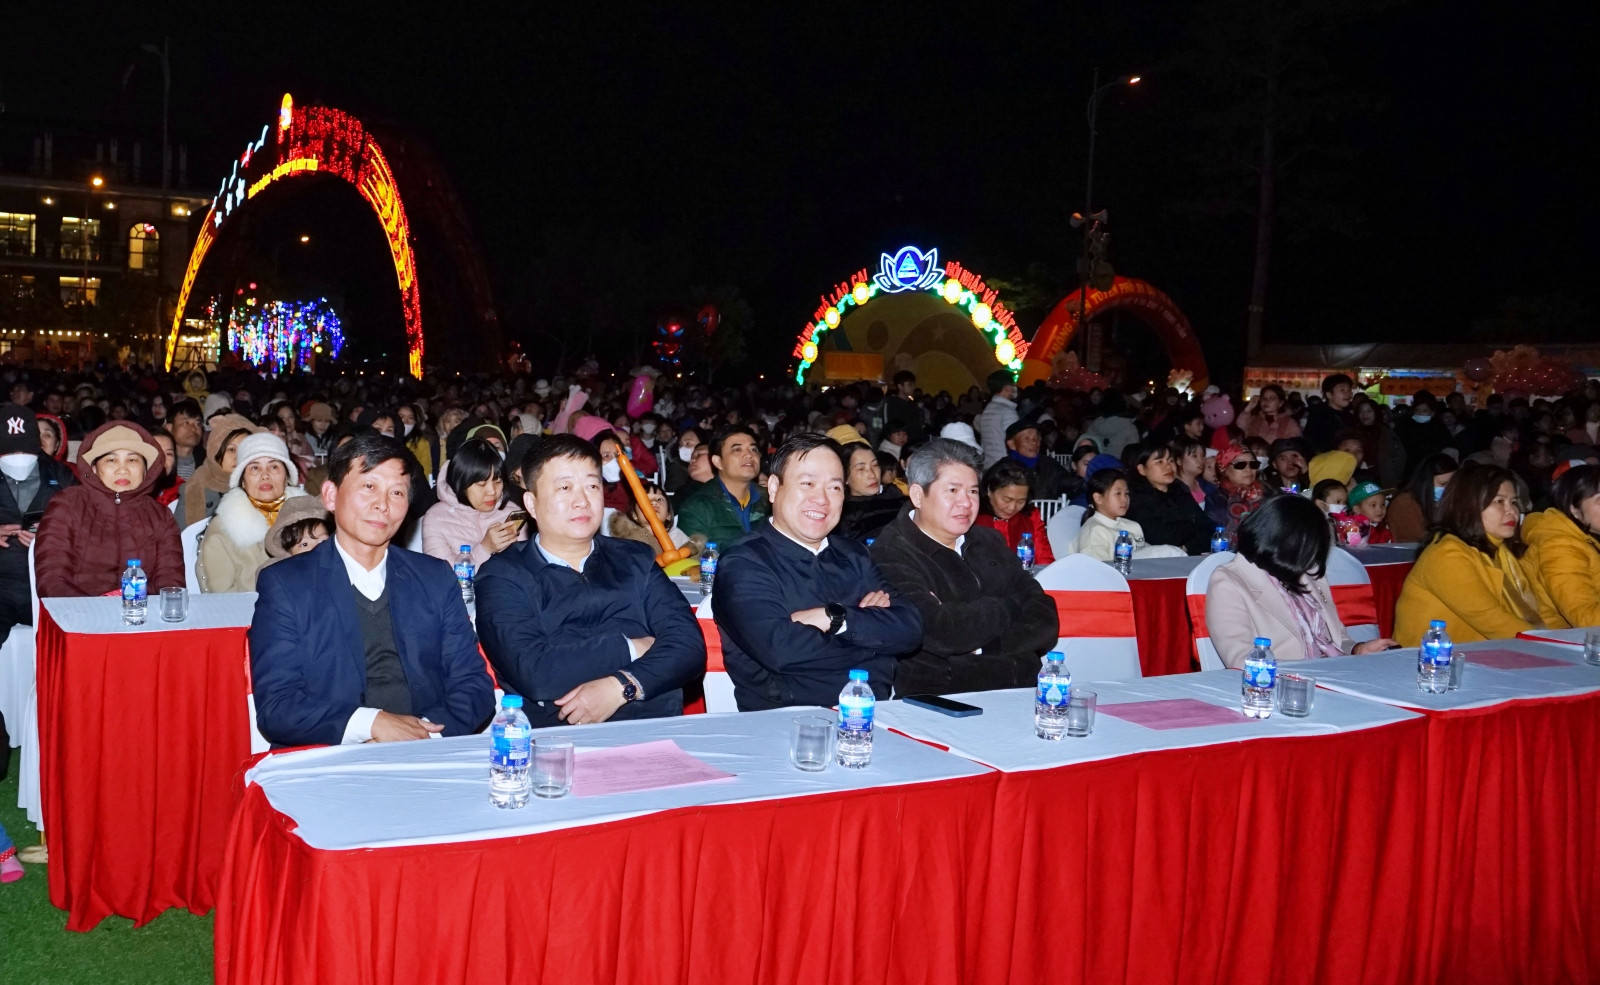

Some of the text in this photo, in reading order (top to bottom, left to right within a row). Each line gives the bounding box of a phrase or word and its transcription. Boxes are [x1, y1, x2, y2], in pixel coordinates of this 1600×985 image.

[829, 281, 850, 305] LÀO
[851, 268, 868, 286] CAI
[981, 287, 999, 308] VÀ
[992, 301, 1016, 329] PHÁT
[7, 416, 26, 435] NY
